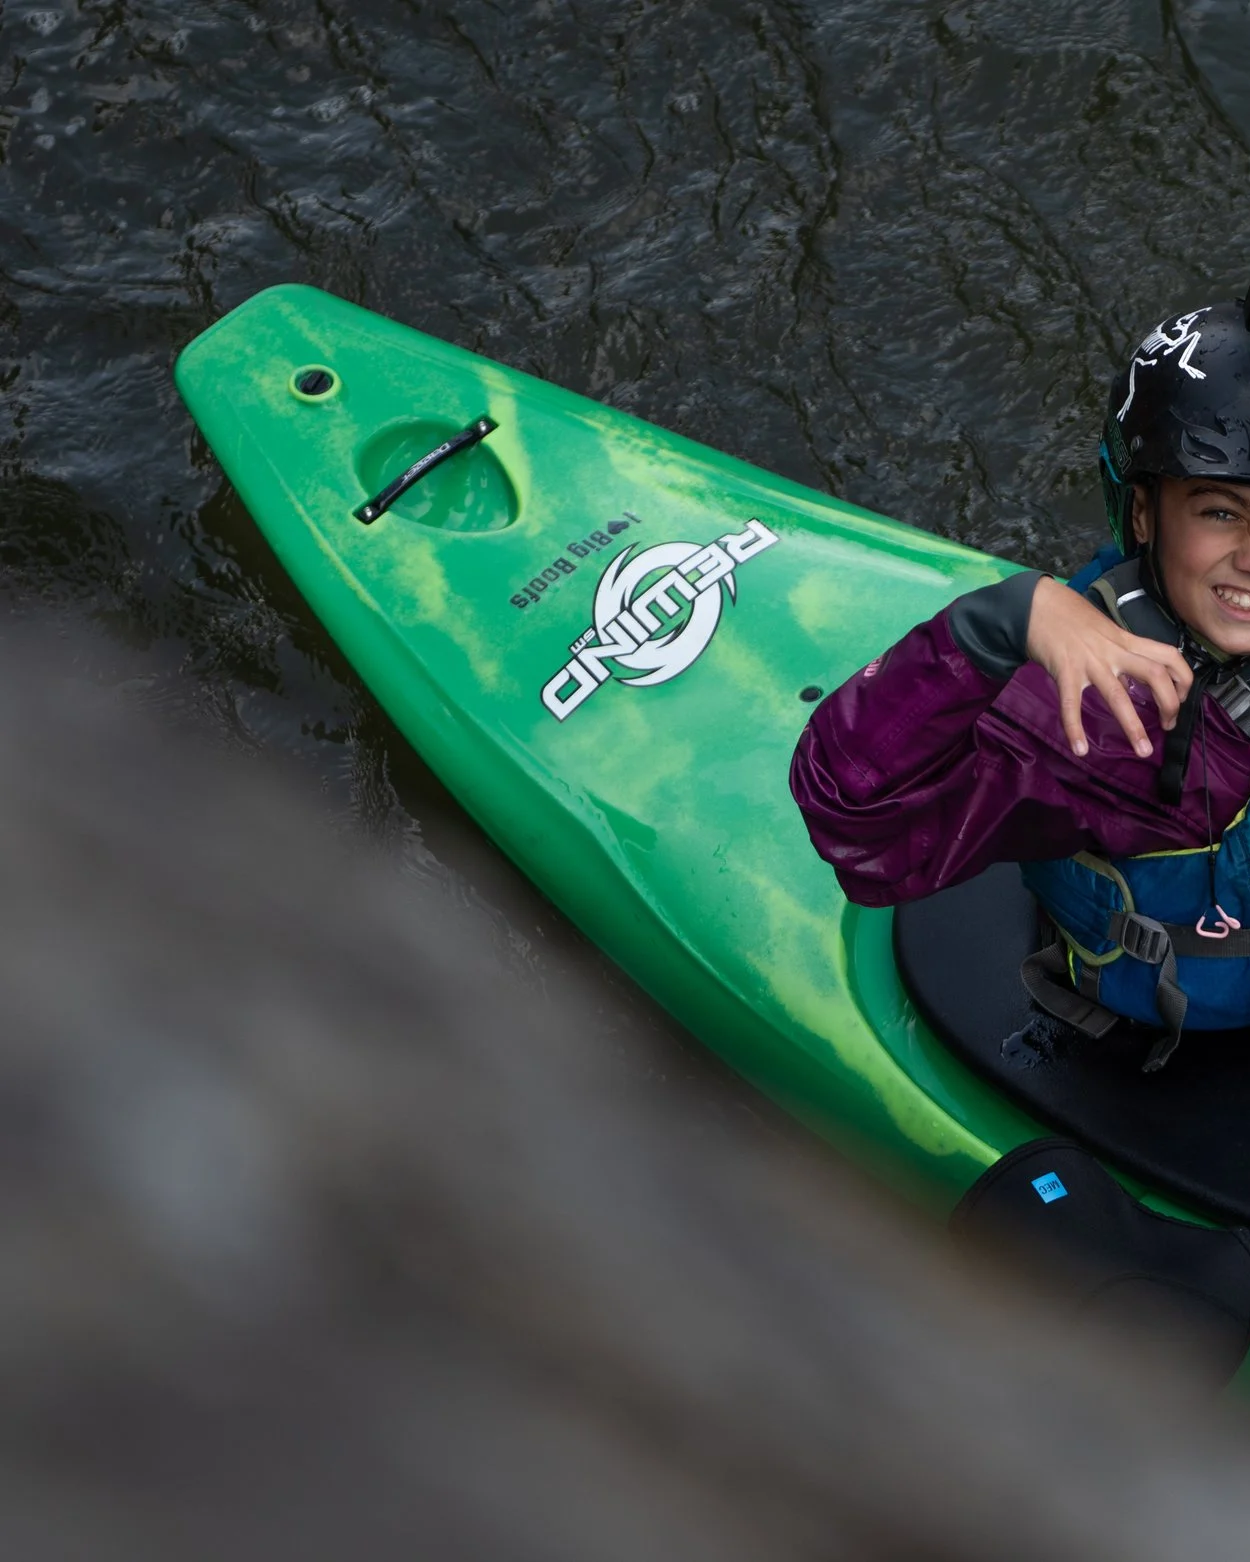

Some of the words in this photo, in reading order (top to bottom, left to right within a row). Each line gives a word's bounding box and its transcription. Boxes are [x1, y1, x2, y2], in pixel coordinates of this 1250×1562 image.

[566, 530, 613, 558] Big
[510, 557, 577, 609] Boofs
[540, 517, 780, 723] REWIND
[1039, 1180, 1060, 1194] MEC
